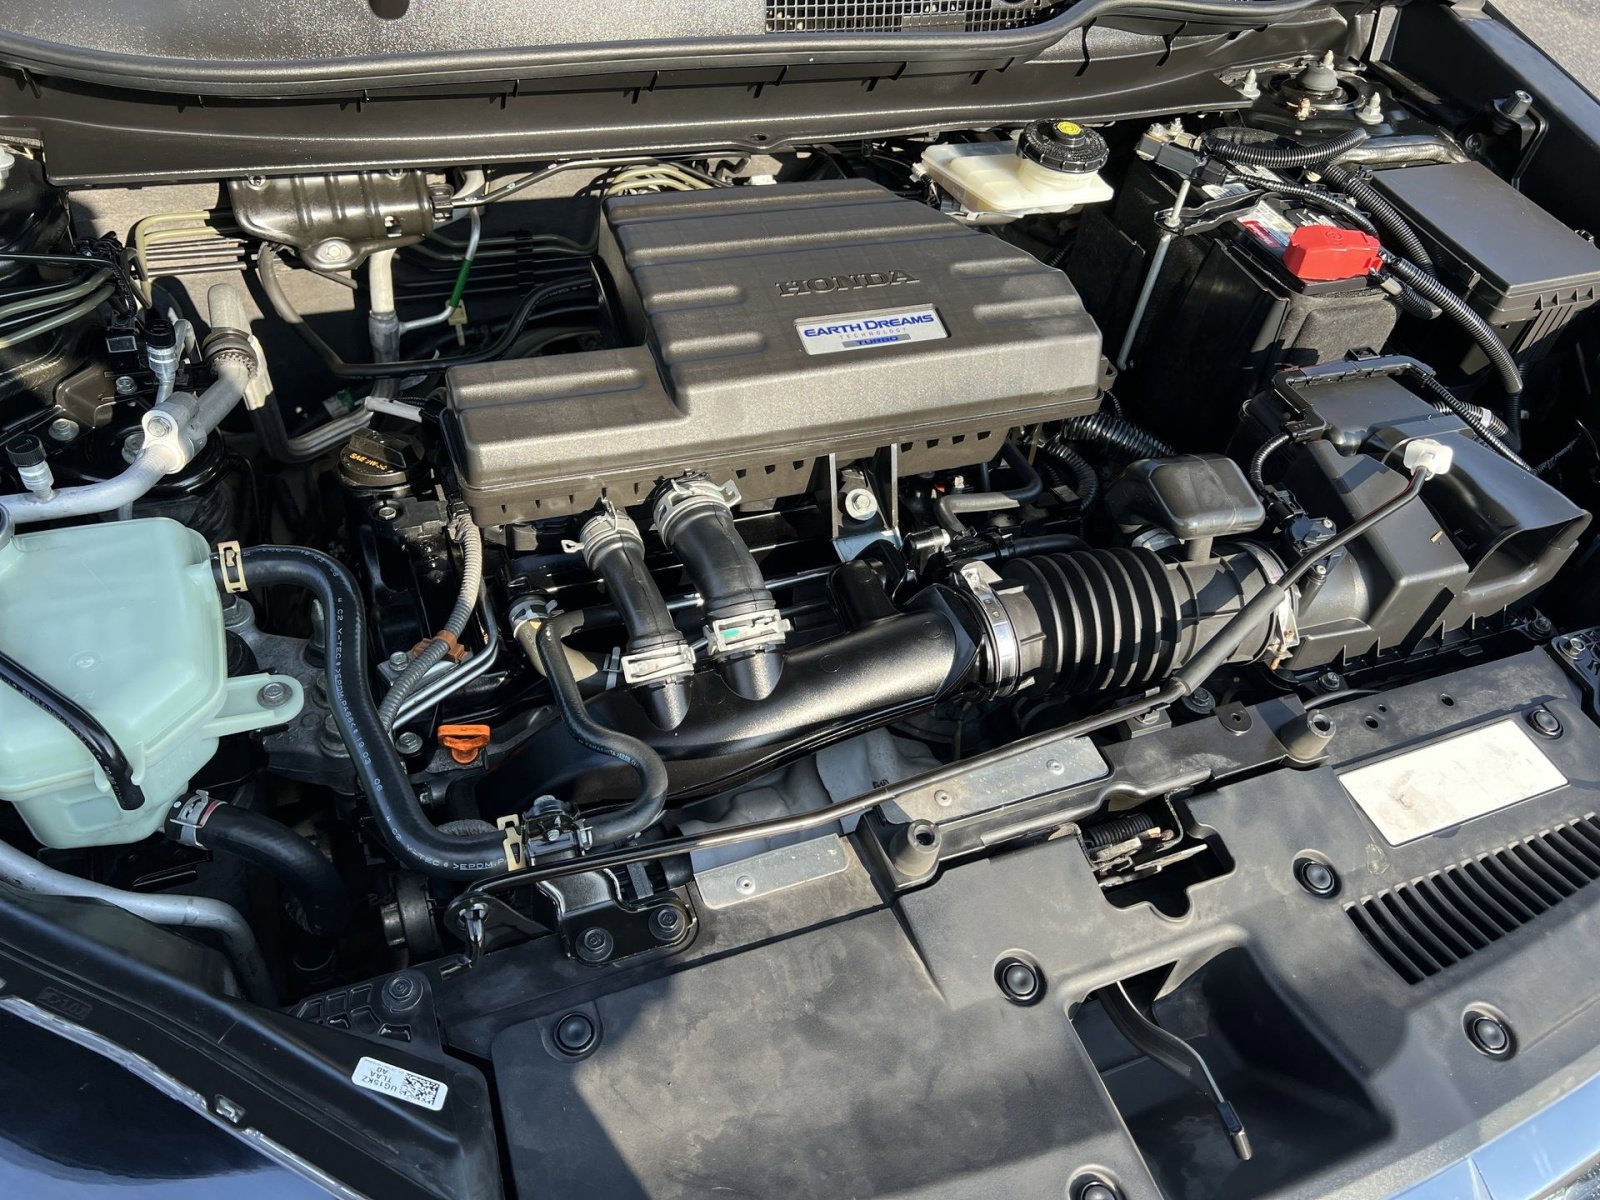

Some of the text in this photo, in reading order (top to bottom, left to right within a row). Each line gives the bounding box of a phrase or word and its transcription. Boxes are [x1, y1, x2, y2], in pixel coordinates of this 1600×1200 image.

[775, 270, 920, 297] HONDA
[804, 314, 934, 338] EARTH DREAMS
[840, 328, 907, 339] TECHNOLOGY
[857, 335, 898, 346] TURBO
